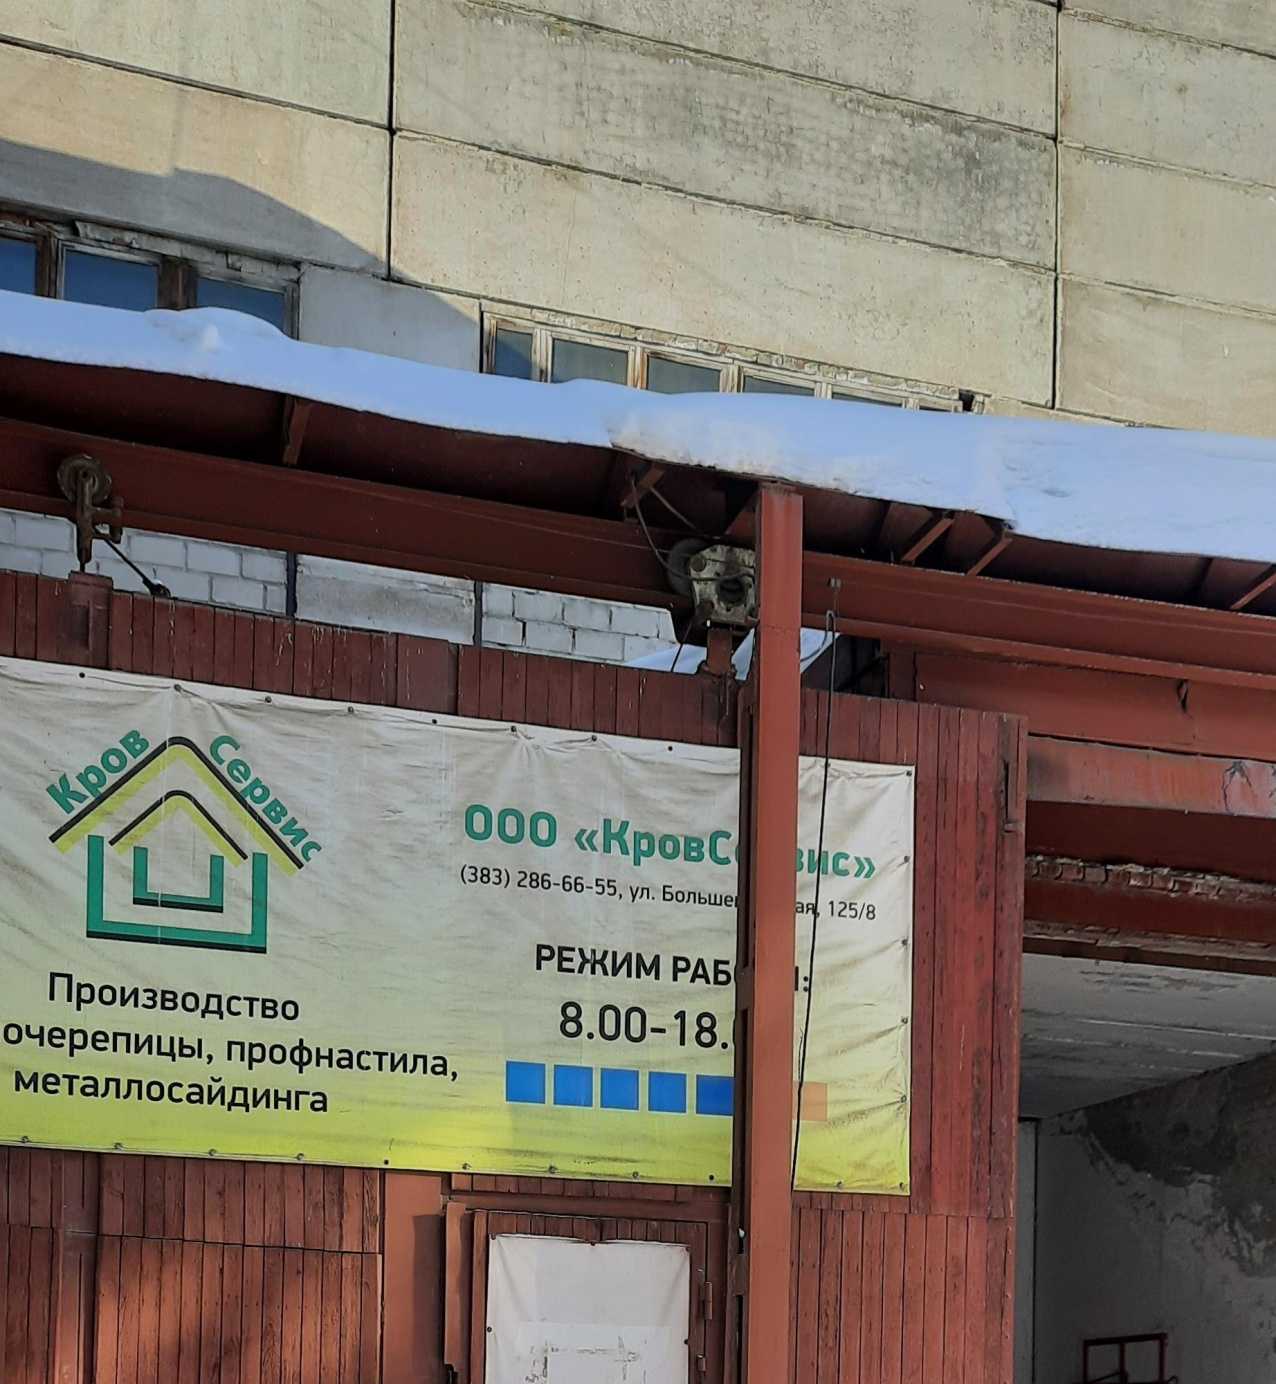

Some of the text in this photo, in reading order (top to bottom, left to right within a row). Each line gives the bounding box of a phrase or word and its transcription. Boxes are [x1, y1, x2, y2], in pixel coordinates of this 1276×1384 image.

[46, 729, 322, 862] Кров Сервис
[464, 803, 876, 879] ООО «КровСис»
[460, 864, 511, 889] (383)
[516, 870, 623, 904] 286-66-55,
[629, 885, 656, 903] ул.
[828, 900, 877, 921] 125/8
[535, 943, 661, 981] РЕЖИМ
[48, 971, 300, 1021] Производство
[3, 1022, 458, 1082] очерепицы, профнастила,
[559, 1001, 737, 1050] 8.00-18.
[14, 1070, 329, 1113] металлосайдинга
